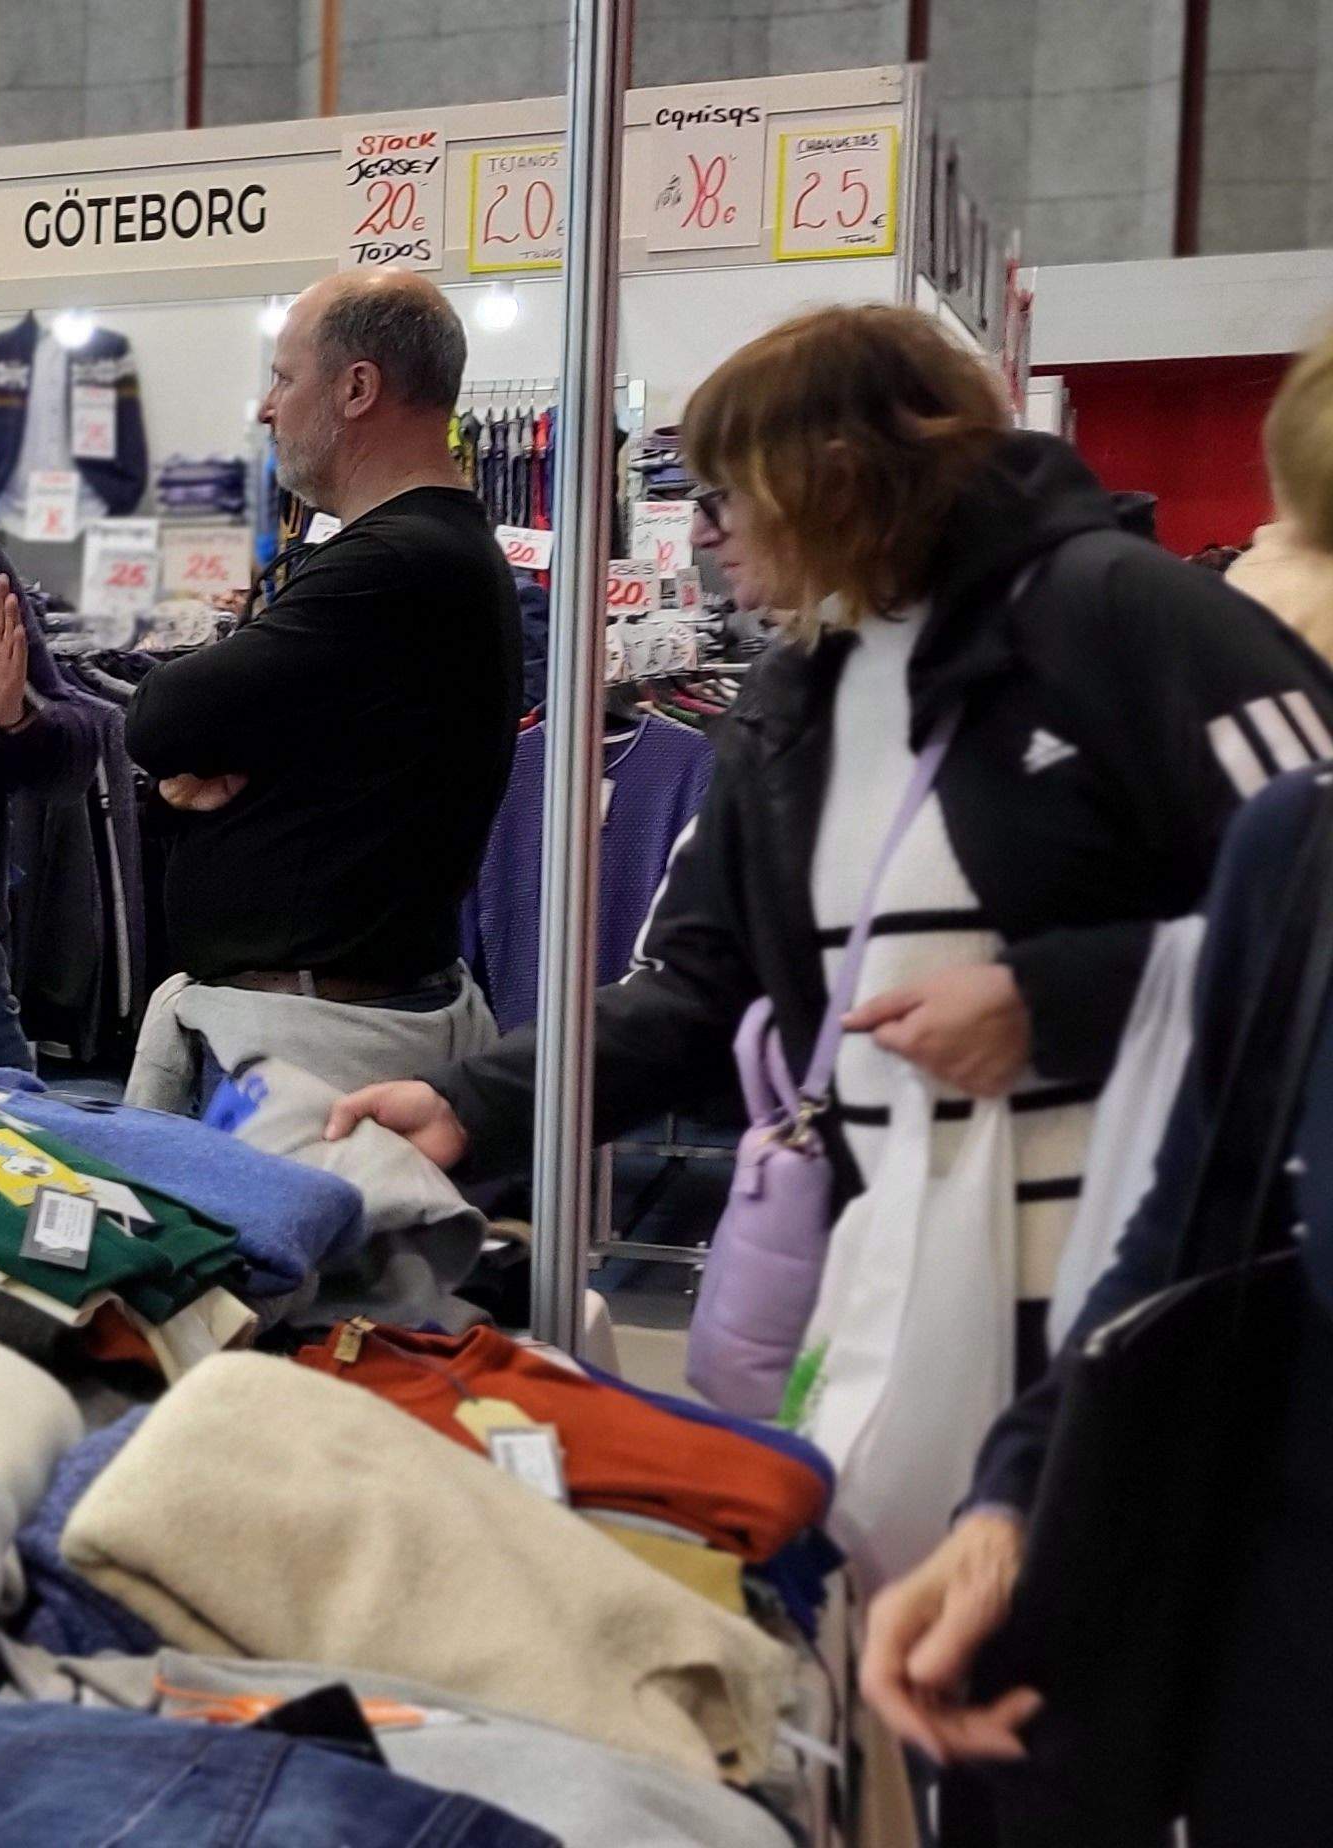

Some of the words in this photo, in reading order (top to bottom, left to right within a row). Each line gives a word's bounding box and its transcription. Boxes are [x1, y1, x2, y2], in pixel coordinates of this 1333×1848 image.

[356, 131, 438, 157] STOCK
[346, 156, 440, 187] JERSEY
[24, 182, 267, 249] GÖTEBORG
[349, 239, 432, 265] TODOS
